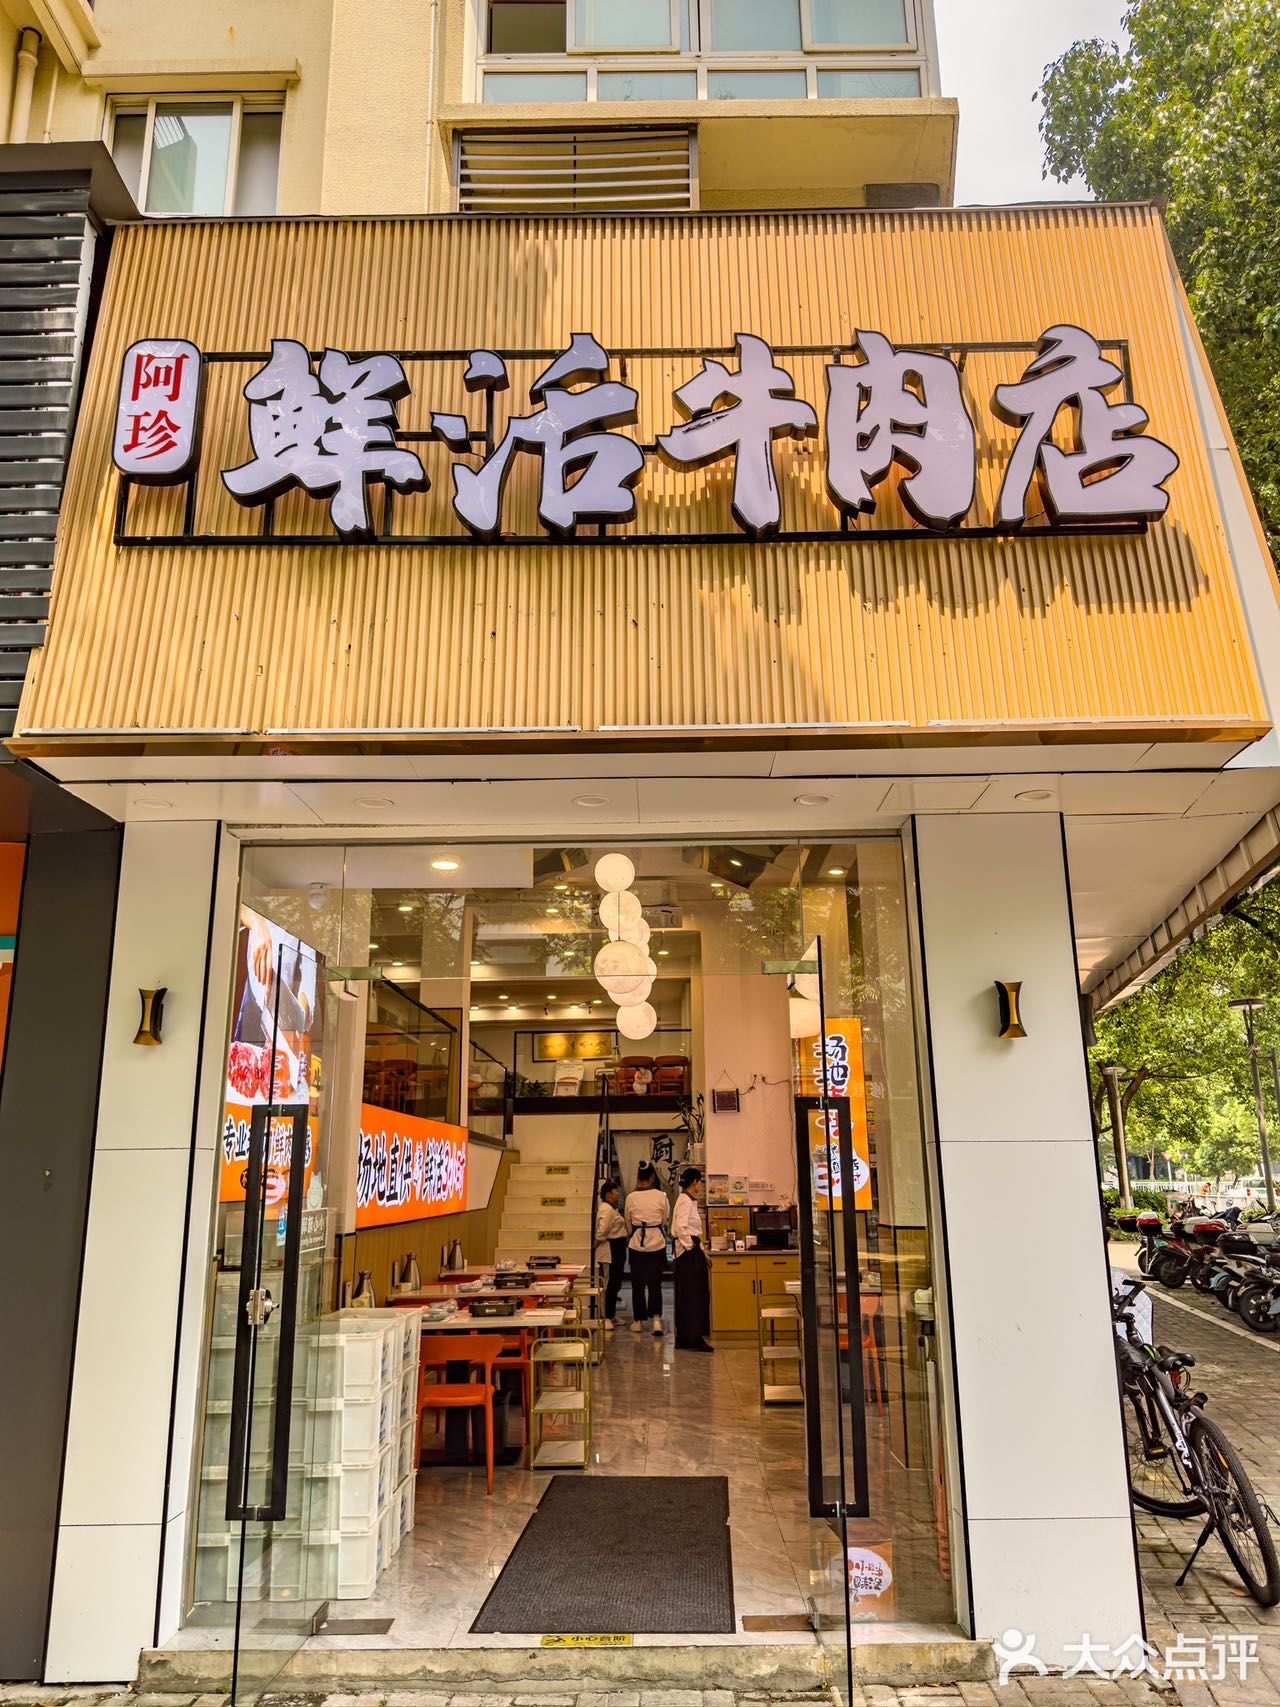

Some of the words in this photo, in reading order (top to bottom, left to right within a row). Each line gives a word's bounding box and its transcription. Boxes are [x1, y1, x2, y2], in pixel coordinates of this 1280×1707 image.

[122, 352, 191, 461] 阿珍
[220, 324, 1180, 535] 鲜活牛肉店
